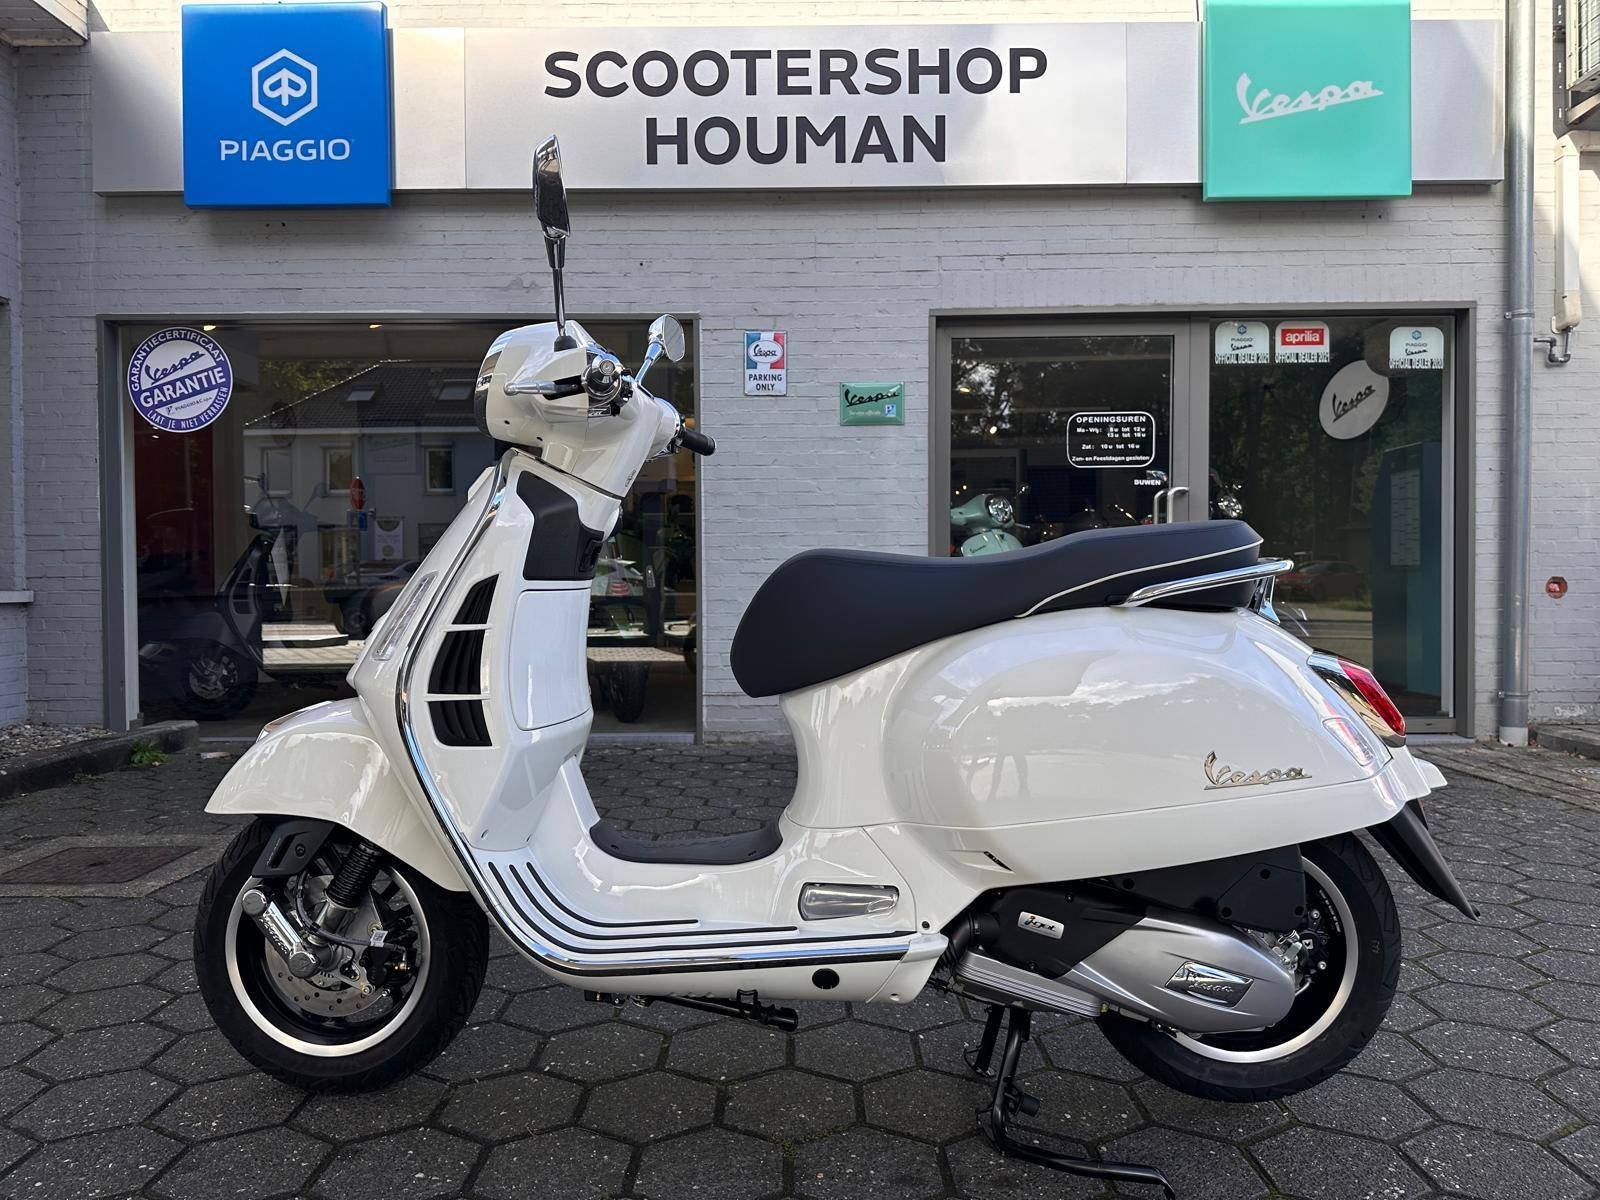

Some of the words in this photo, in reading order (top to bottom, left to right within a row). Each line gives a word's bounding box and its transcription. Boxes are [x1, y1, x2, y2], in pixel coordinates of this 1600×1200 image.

[544, 47, 1048, 98] SCOOTERSHOP
[1236, 72, 1384, 125] Vespa
[220, 138, 351, 161] PIAGGIO
[646, 115, 946, 165] HOUMAN
[753, 344, 778, 357] Vespa
[1285, 331, 1320, 344] aprilia
[132, 330, 225, 391] GARANTIECERTIFICAAT
[145, 351, 206, 385] Vespa
[140, 368, 226, 407] GARANTIE
[755, 383, 775, 391] ONLY
[845, 388, 900, 407] Vespa
[1332, 385, 1376, 423] Vespa
[147, 409, 165, 425] LAAT
[167, 419, 176, 430] JE
[181, 419, 199, 429] NIET
[199, 387, 228, 423] VERRASSEN
[1204, 750, 1312, 791] Vespa
